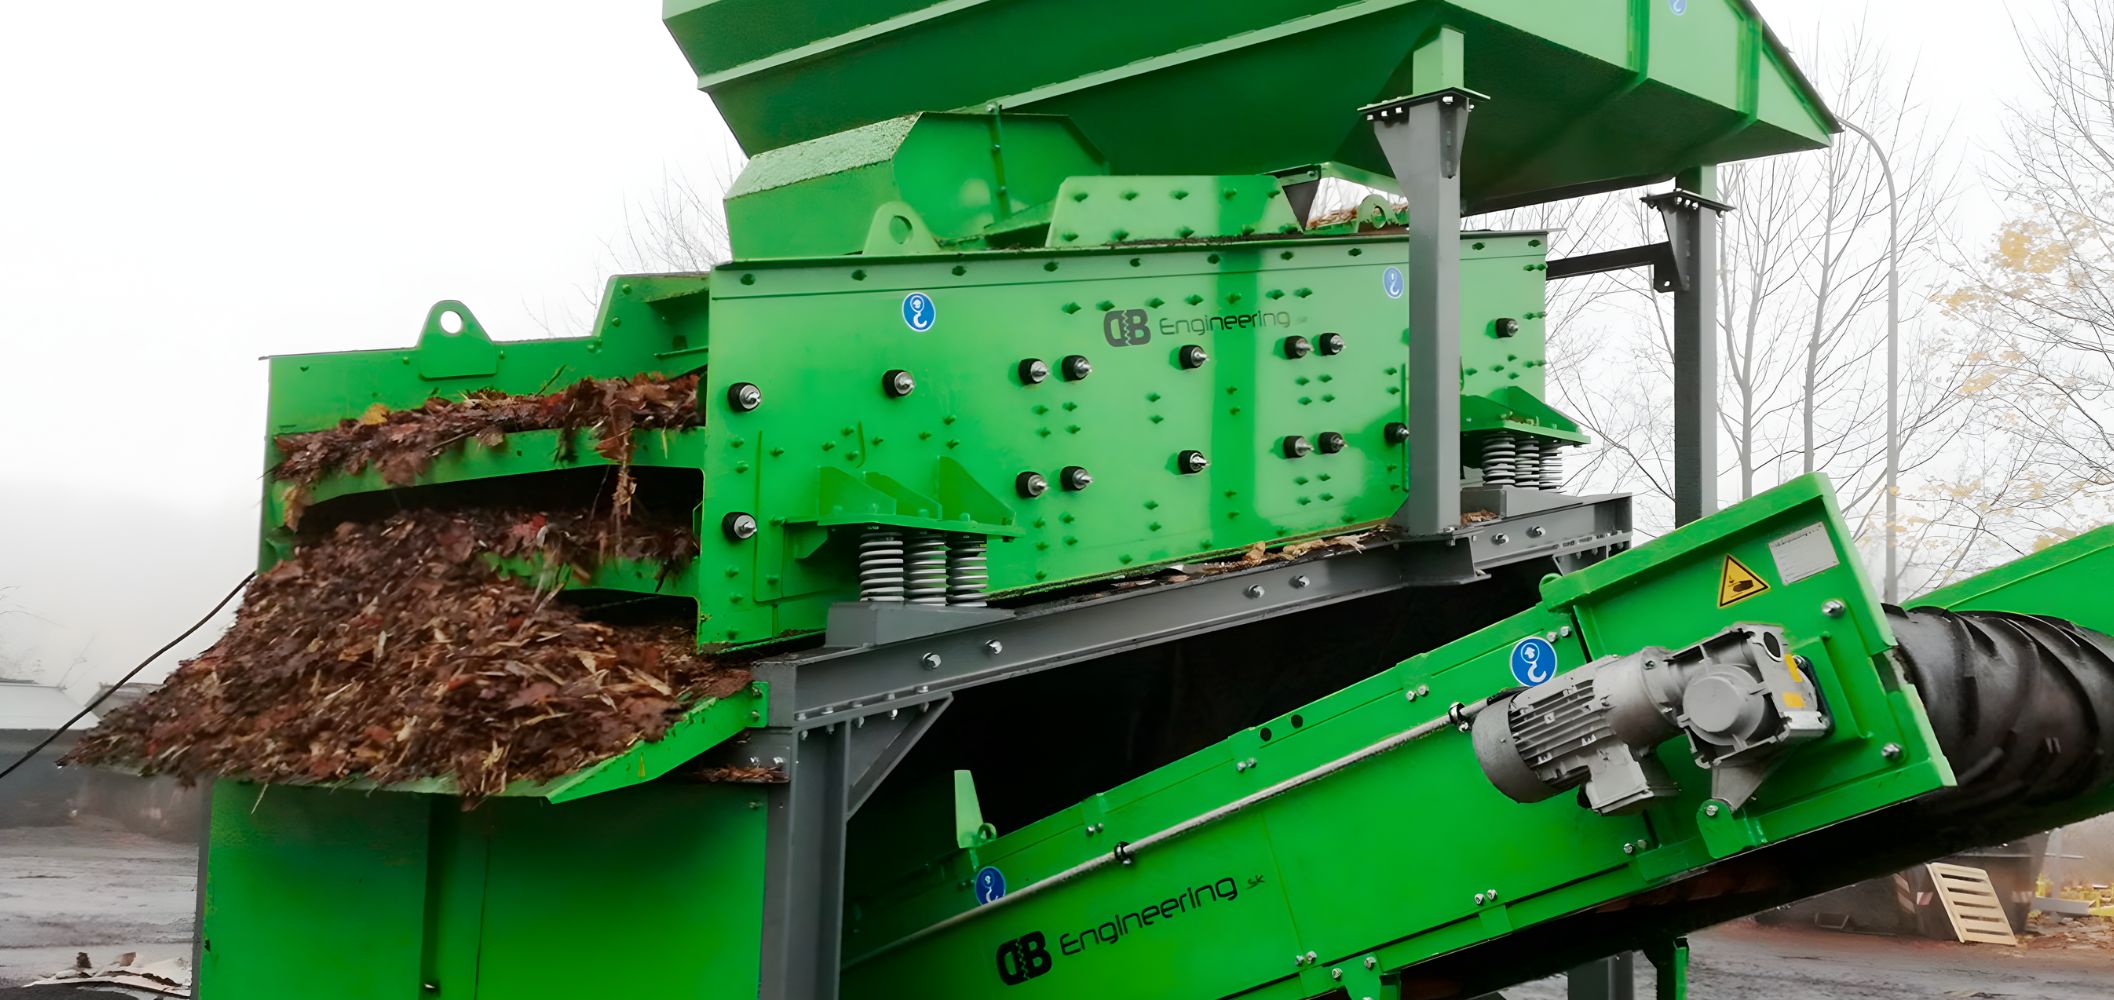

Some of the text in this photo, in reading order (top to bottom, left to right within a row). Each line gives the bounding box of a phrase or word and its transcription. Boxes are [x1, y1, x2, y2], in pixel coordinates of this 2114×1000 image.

[1103, 308, 1291, 347] DB Engineering
[996, 930, 1053, 986] DB
[1059, 877, 1238, 956] Engineering
